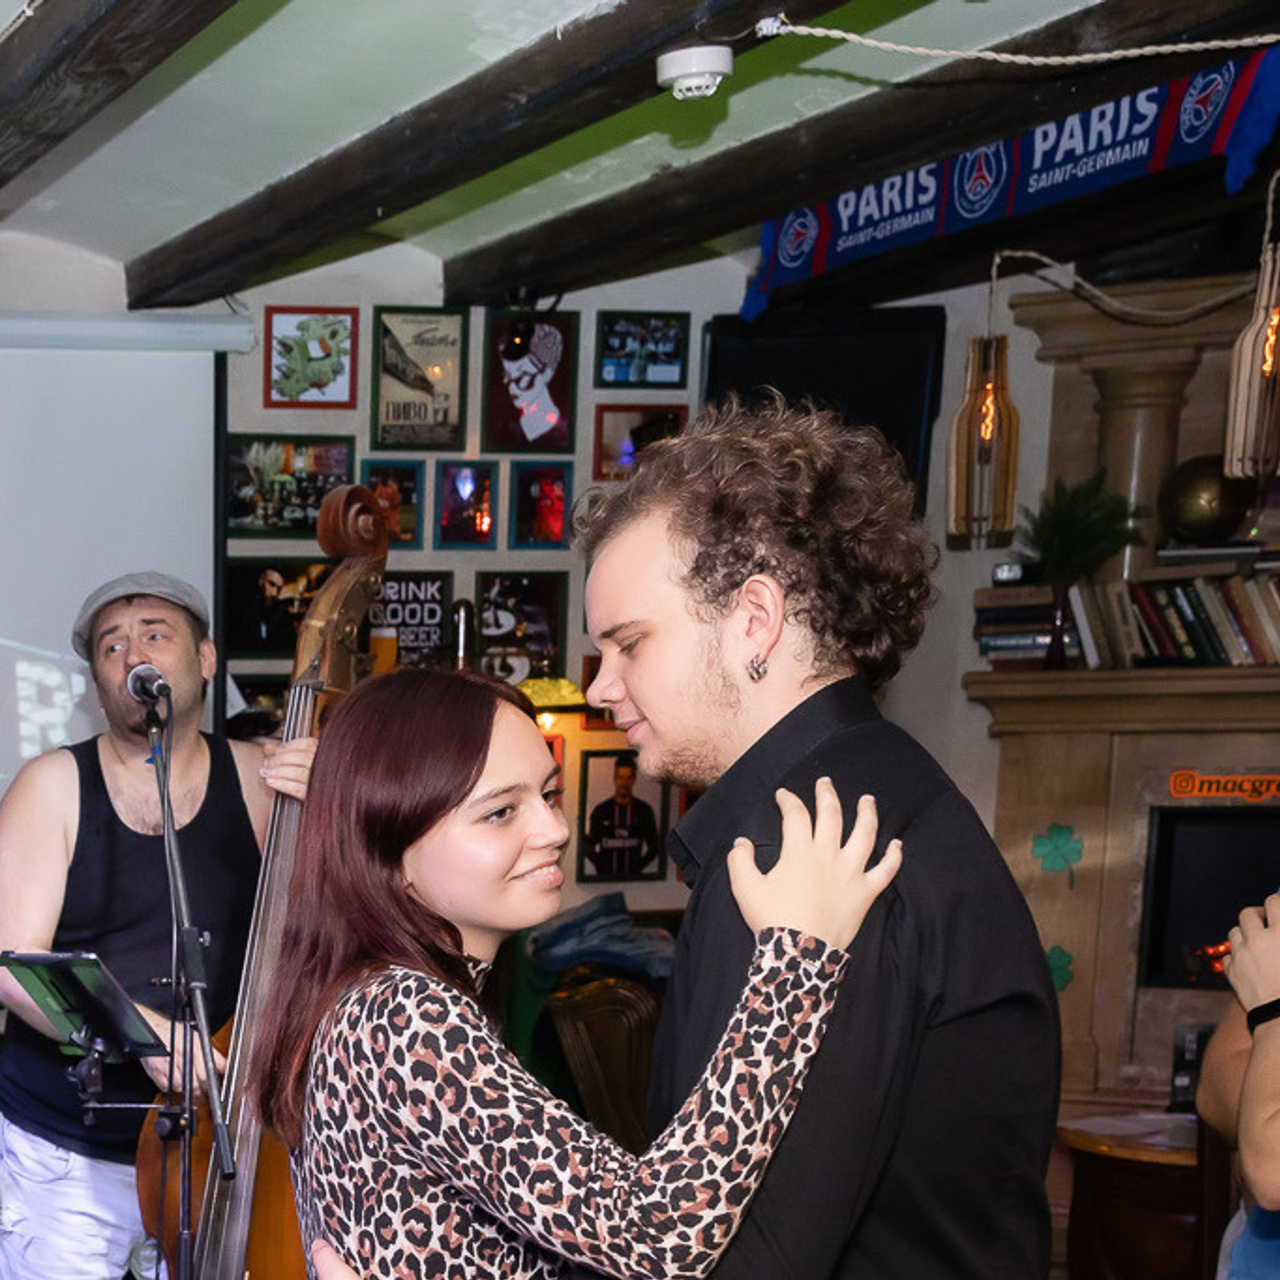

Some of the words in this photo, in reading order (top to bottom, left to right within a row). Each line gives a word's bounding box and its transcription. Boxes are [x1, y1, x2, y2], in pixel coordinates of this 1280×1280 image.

[1031, 86, 1159, 170] PARIS
[1027, 137, 1150, 193] SAINT-GERMAIN
[837, 162, 938, 232] PARIS
[398, 626, 441, 647] BEER
